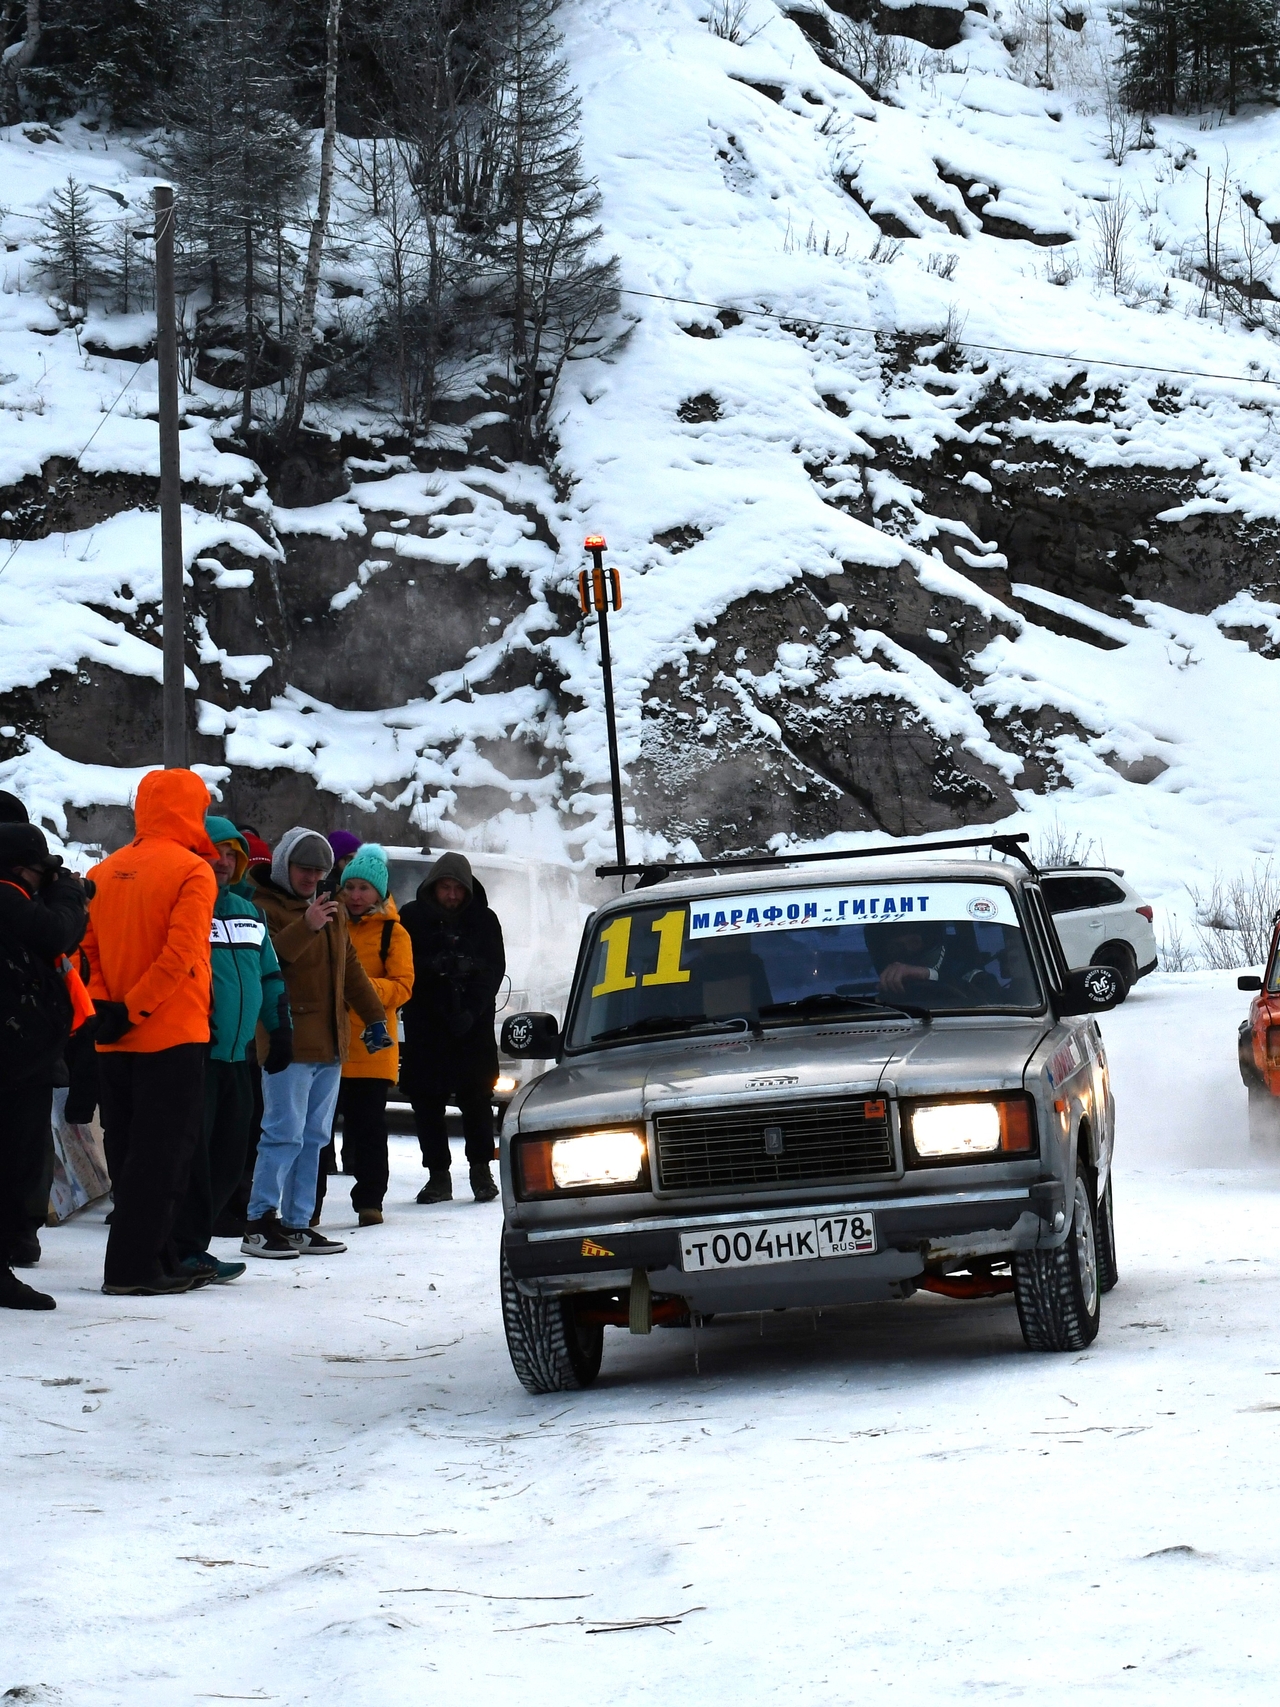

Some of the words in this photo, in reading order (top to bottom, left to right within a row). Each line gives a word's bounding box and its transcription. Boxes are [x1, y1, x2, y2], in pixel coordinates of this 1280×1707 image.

[715, 919, 745, 933] 25
[753, 914, 812, 928] часов
[822, 915, 846, 923] на
[591, 910, 690, 998] 11
[819, 1217, 866, 1244] 178
[831, 1241, 856, 1253] RUS
